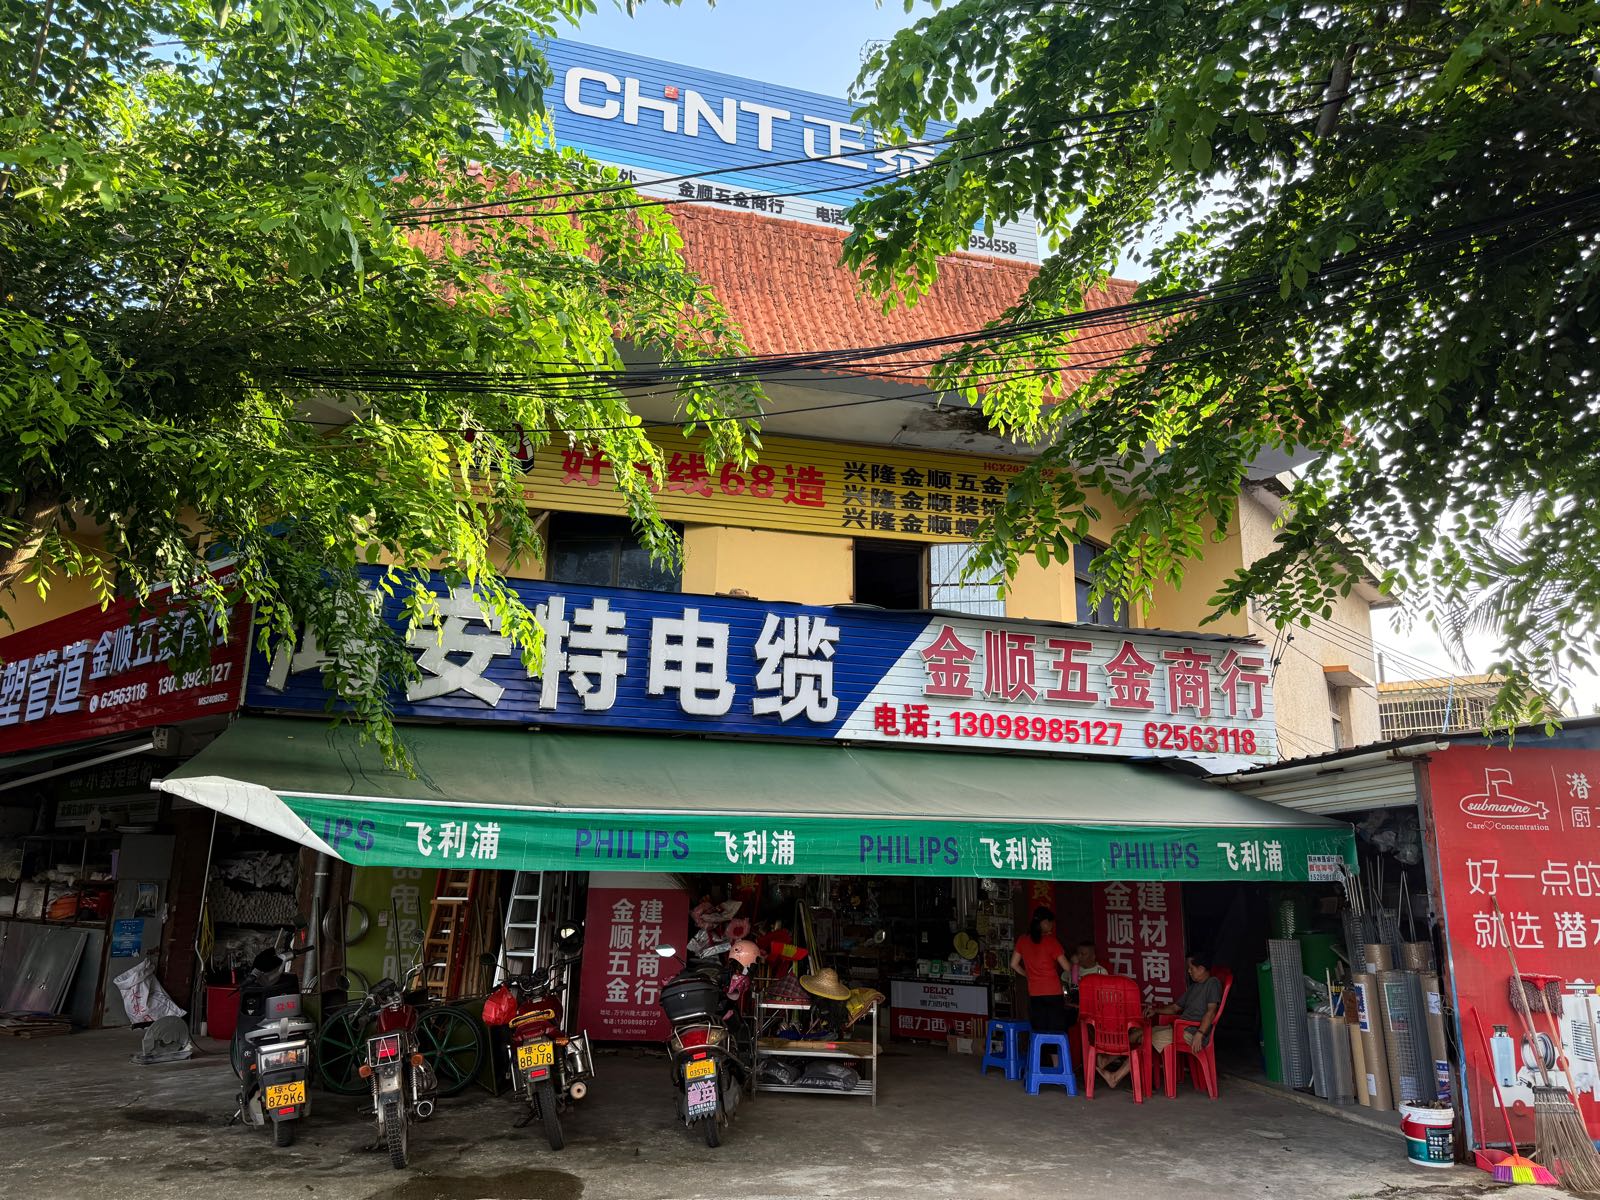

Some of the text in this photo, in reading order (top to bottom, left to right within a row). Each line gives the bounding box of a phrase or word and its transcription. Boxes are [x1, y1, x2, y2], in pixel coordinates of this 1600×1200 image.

[678, 182, 785, 215] 金顺五金商行
[843, 461, 1056, 496] 兴隆金顺五金
[842, 484, 1040, 520] 兴隆金顺装饰
[266, 582, 840, 723] 安特电缆
[919, 624, 1270, 720] 金顺五金商行
[101, 683, 148, 709] 62563118
[1143, 722, 1257, 755] 62563118
[1467, 799, 1531, 814] submarine
[1571, 806, 1600, 828] 厨
[1466, 822, 1550, 831] Care Concentration
[303, 816, 1284, 872] IPS 飞利浦 PHILIPS 飞利浦 PHILIPS 飞利浦 PHILIPS 飞利浦
[605, 898, 636, 1003] 金顺五金
[634, 898, 665, 1005] 建材商行
[923, 986, 954, 995] DELIXI
[519, 1052, 553, 1068] 8BJ78
